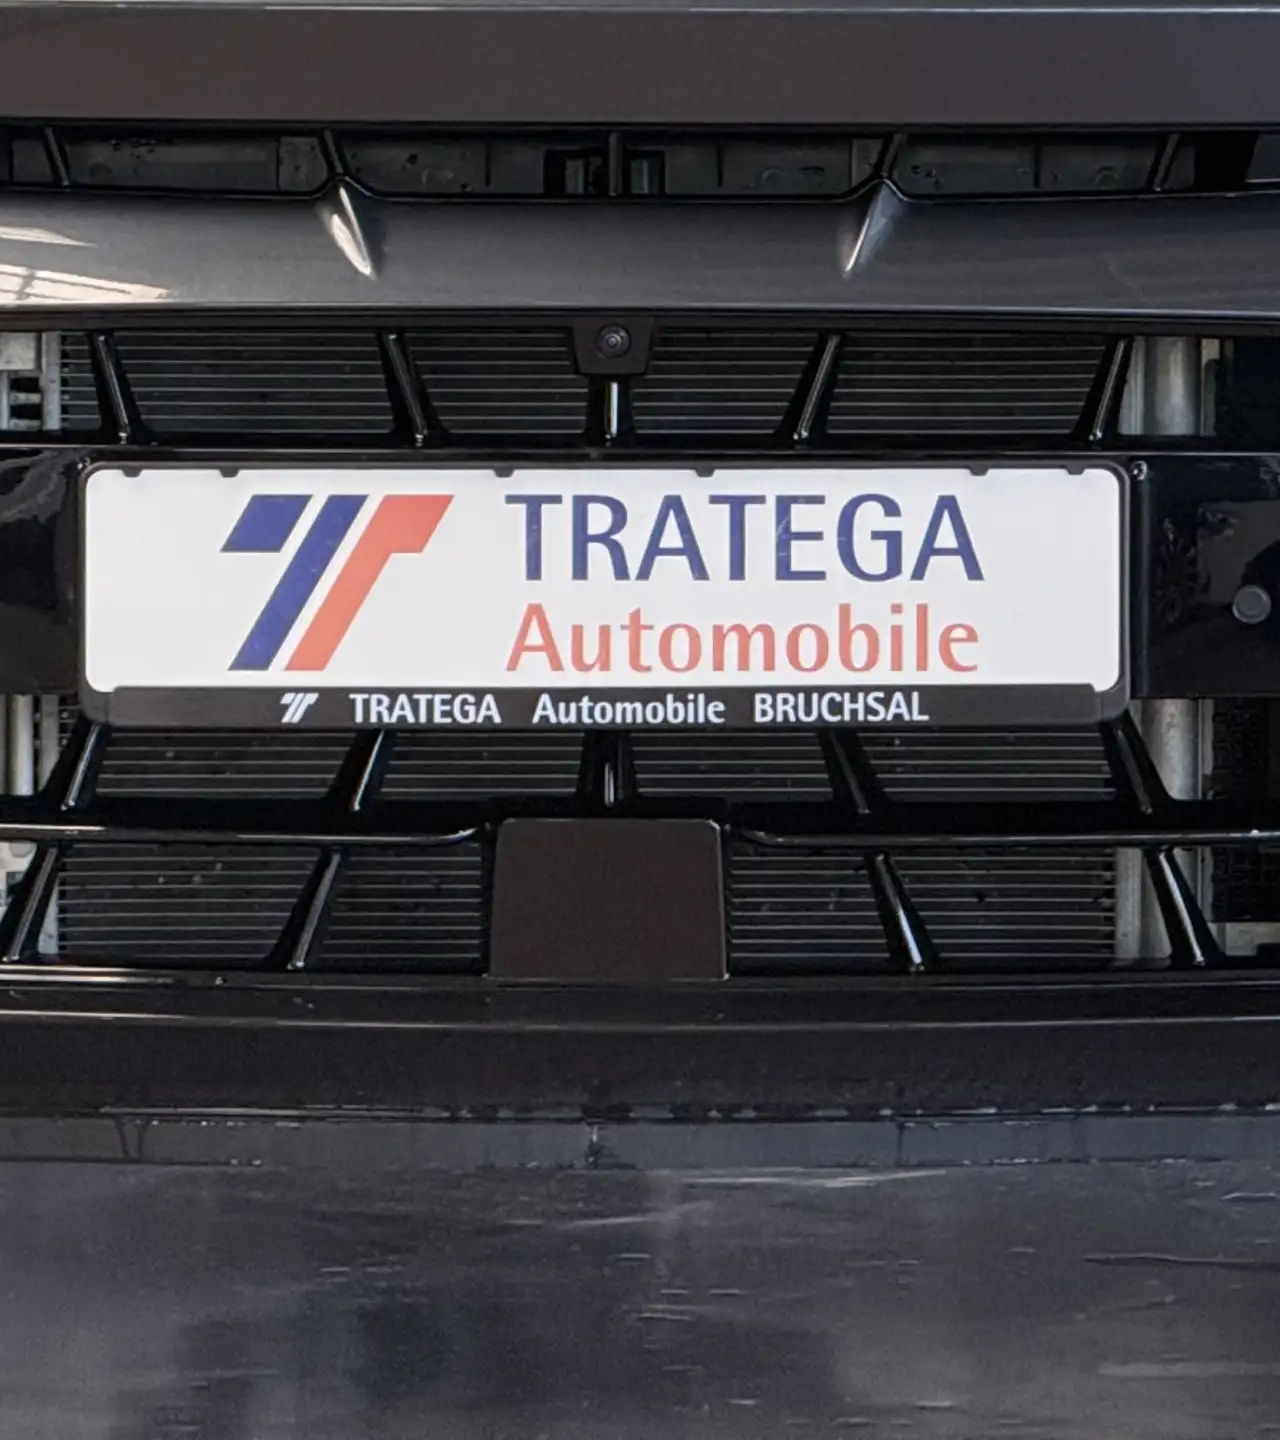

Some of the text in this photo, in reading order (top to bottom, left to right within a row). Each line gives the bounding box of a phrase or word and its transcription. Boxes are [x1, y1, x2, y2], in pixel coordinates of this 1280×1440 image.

[505, 494, 984, 581] TRATEGA
[505, 603, 980, 673] Automobile
[349, 691, 930, 725] TRATEGA Automobile BRUCHSAL
